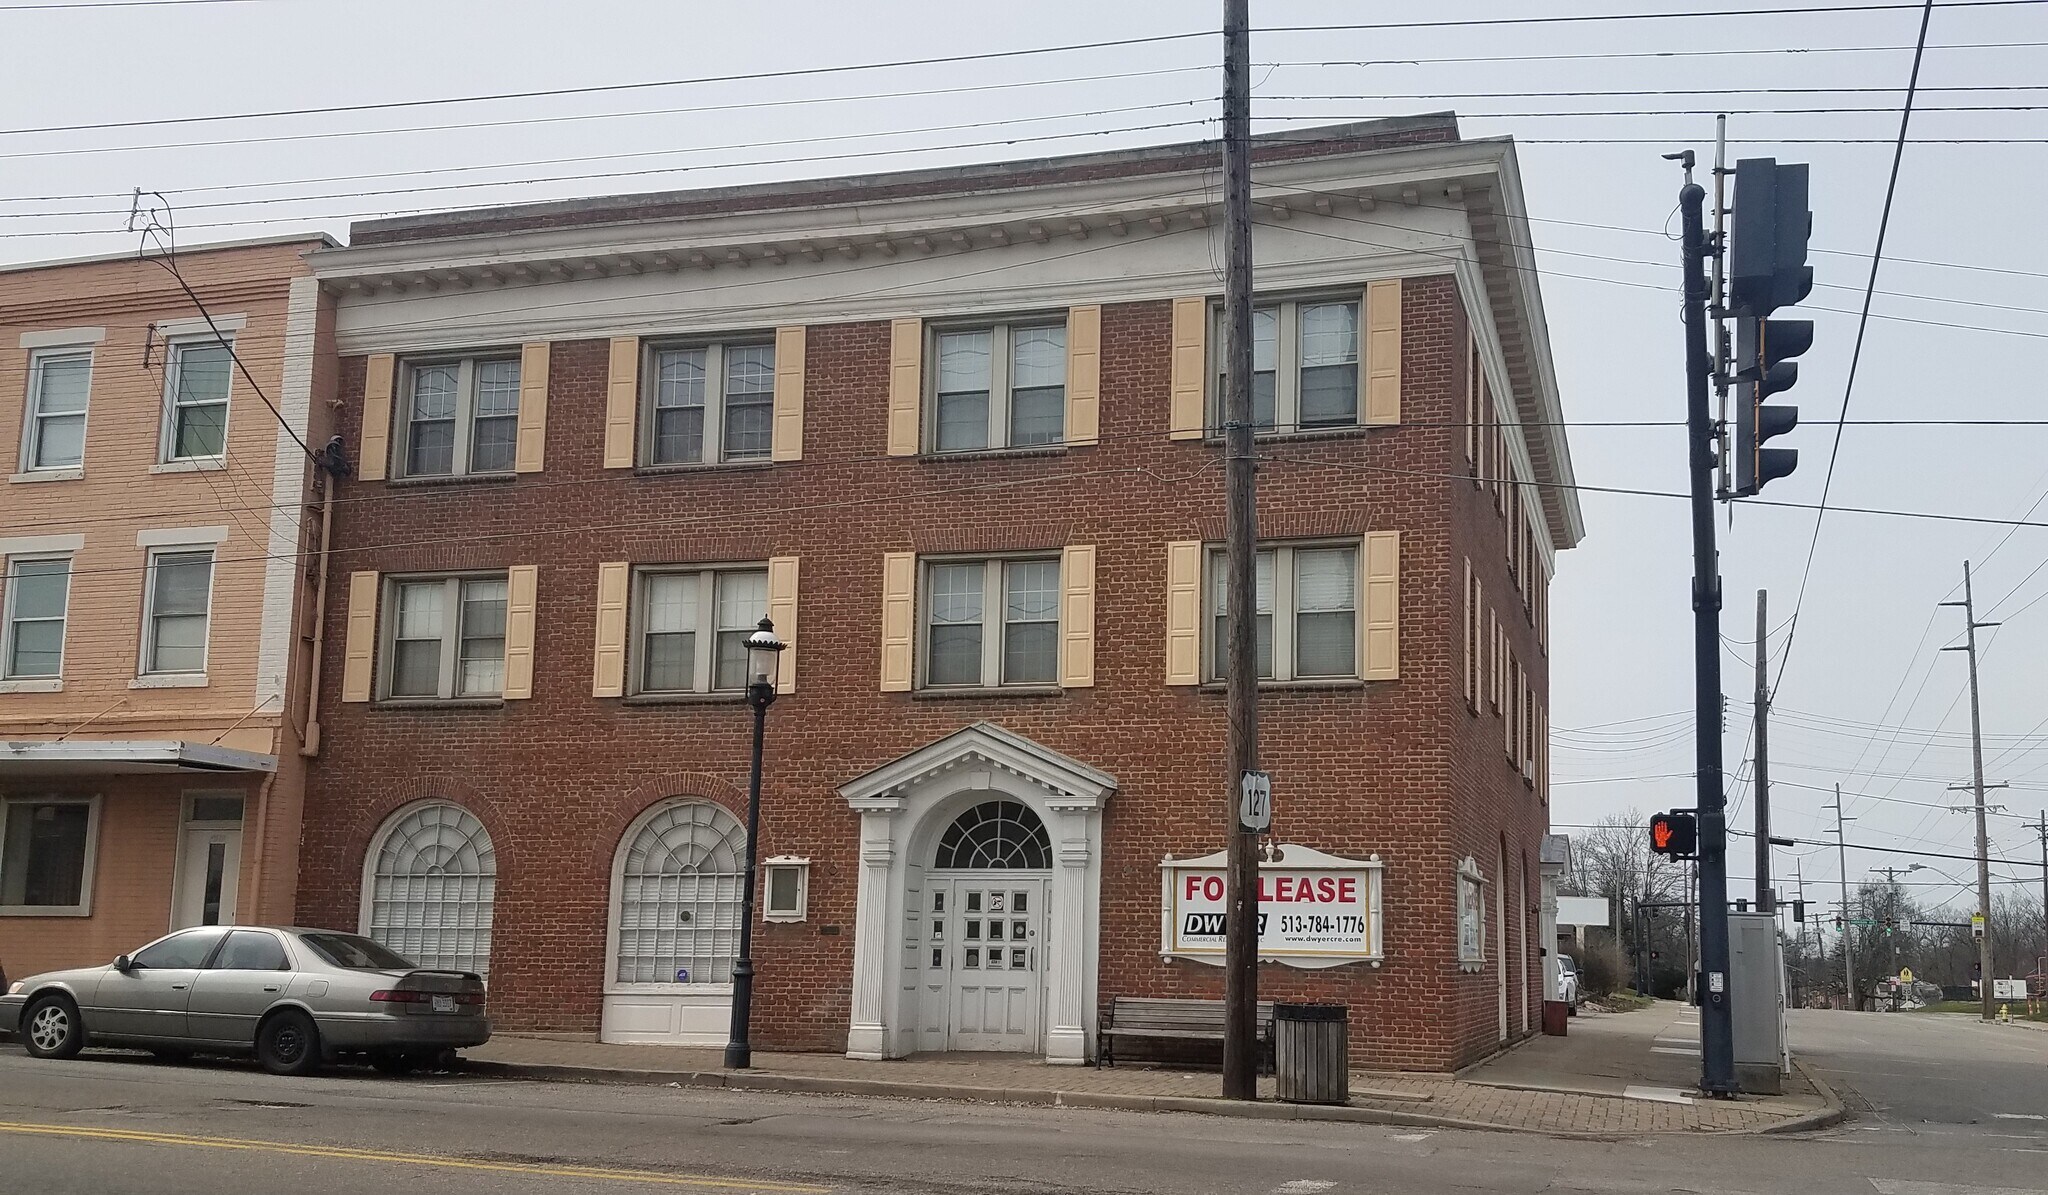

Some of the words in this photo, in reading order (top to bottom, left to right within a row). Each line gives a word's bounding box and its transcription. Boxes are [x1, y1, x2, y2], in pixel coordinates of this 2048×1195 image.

[1248, 789, 1266, 816] 127
[1185, 876, 1225, 901] FO
[1257, 877, 1356, 903] LEASE
[1186, 915, 1264, 933] DWR
[1281, 915, 1365, 933] 513-784-1776
[1284, 935, 1362, 944] www.dwyercre.com
